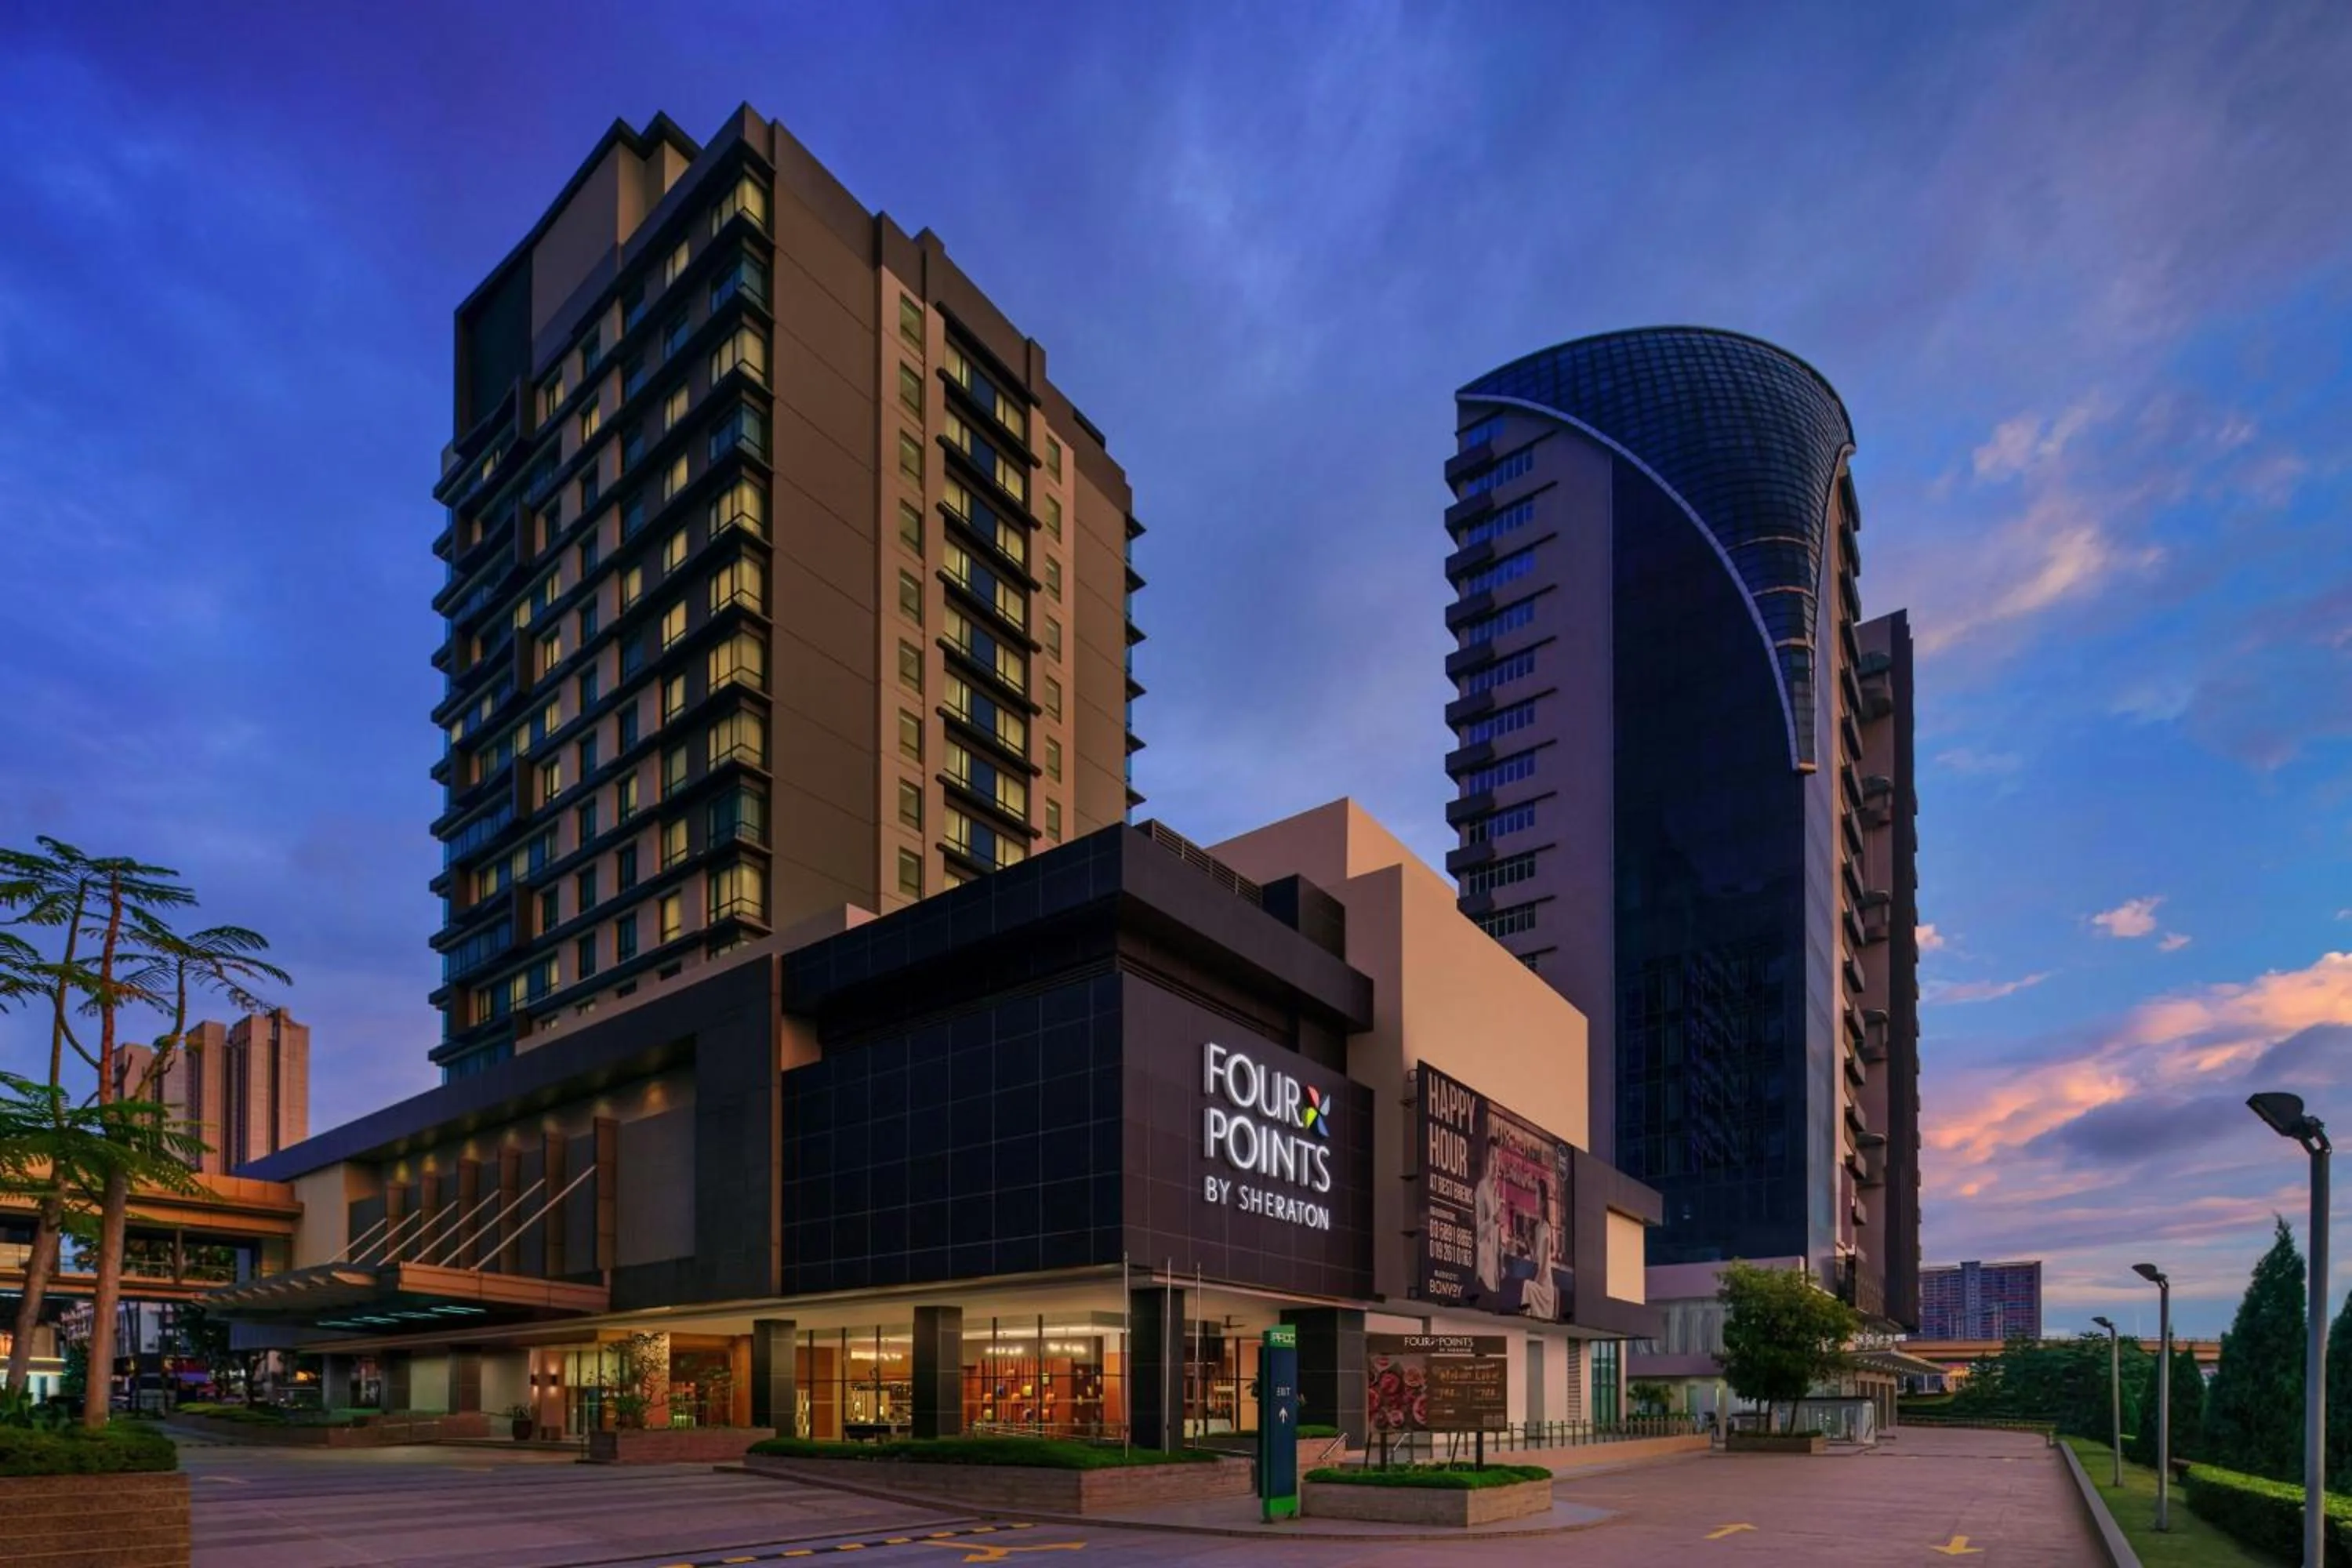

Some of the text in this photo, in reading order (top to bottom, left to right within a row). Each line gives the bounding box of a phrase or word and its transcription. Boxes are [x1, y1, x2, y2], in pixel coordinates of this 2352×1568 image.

[1204, 1042, 1304, 1128] FOUR
[1428, 1072, 1475, 1134] HAPPY
[1204, 1107, 1330, 1192] POINTS
[1429, 1122, 1468, 1179] HOUR
[1204, 1176, 1330, 1230] BY SHERATON
[1404, 1337, 1474, 1348] FOUR POINTS
